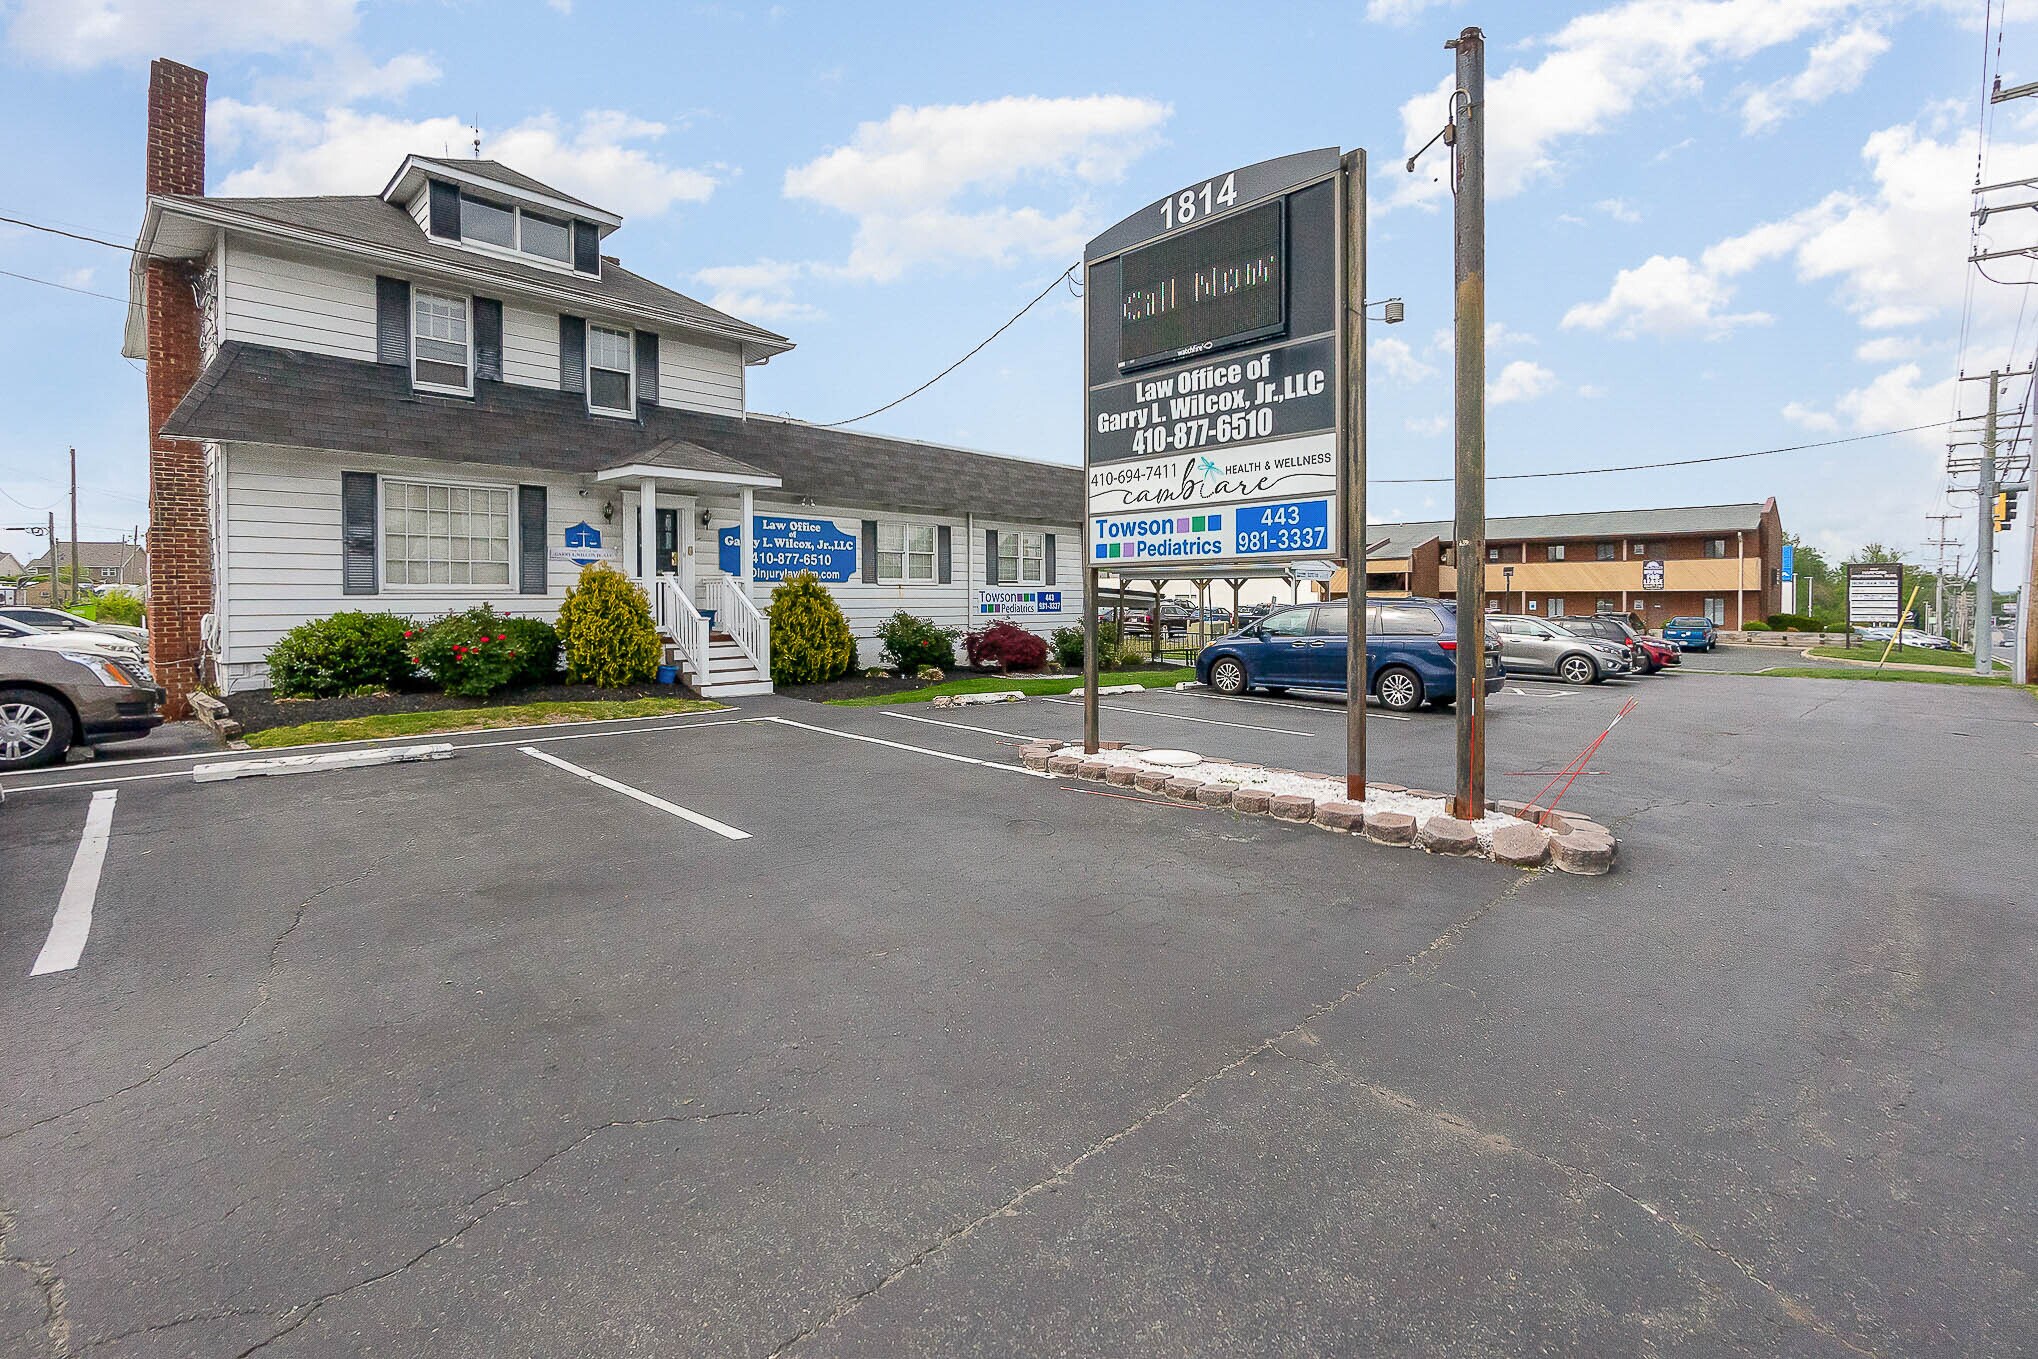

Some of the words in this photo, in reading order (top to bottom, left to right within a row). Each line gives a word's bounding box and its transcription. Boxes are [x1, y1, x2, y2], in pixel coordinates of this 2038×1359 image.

[1159, 172, 1238, 230] 1814
[1135, 378, 1174, 404] Law
[1177, 364, 1242, 395] Office
[1246, 353, 1271, 381] of
[1097, 407, 1149, 434] Garry
[1151, 402, 1167, 424] L.
[1169, 389, 1251, 420] Wilcox,
[1132, 407, 1273, 455] 410-877-6510
[1225, 462, 1261, 476] HEALTH
[1264, 460, 1271, 471] &
[1274, 452, 1332, 469] WELLNESS
[1091, 463, 1177, 487] 410-694-7411
[762, 519, 786, 530] Law
[789, 521, 821, 533] Office
[1260, 505, 1300, 527] 443
[788, 531, 797, 539] of
[1096, 518, 1174, 539] Towson
[1238, 526, 1325, 551] 981-3337
[724, 535, 760, 549] Gay
[762, 537, 773, 548] L.
[773, 538, 815, 552] Wilcox,
[1137, 537, 1222, 557] Pediatrics
[752, 552, 832, 566] 410-877-6510
[979, 591, 1016, 602] Towson
[1001, 603, 1034, 613] Pediatrics
